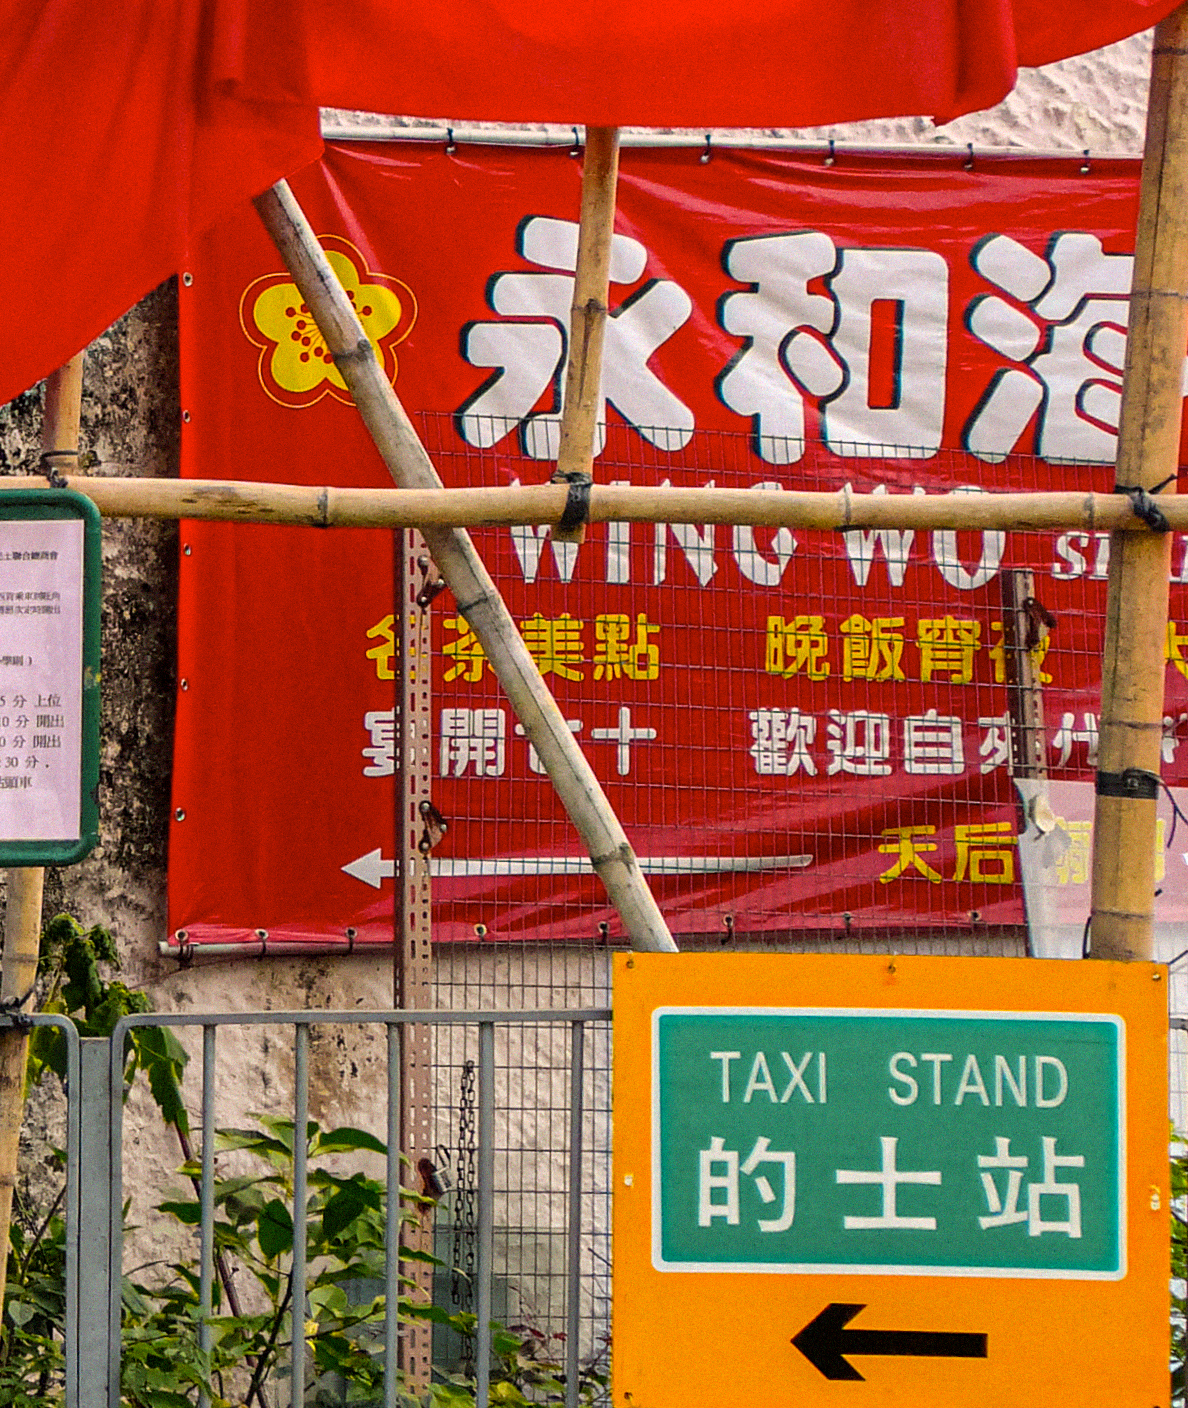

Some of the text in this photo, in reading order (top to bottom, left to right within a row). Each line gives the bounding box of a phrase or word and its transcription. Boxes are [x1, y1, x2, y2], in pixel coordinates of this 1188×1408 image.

[13, 694, 27, 709] 分
[34, 693, 61, 708] 上位
[15, 714, 30, 728] 分
[36, 714, 65, 729] 開出
[13, 734, 27, 749] 分
[33, 734, 62, 749] 開出
[710, 1051, 1069, 1109] TAXI STAND
[697, 1136, 1086, 1239] 的士站
